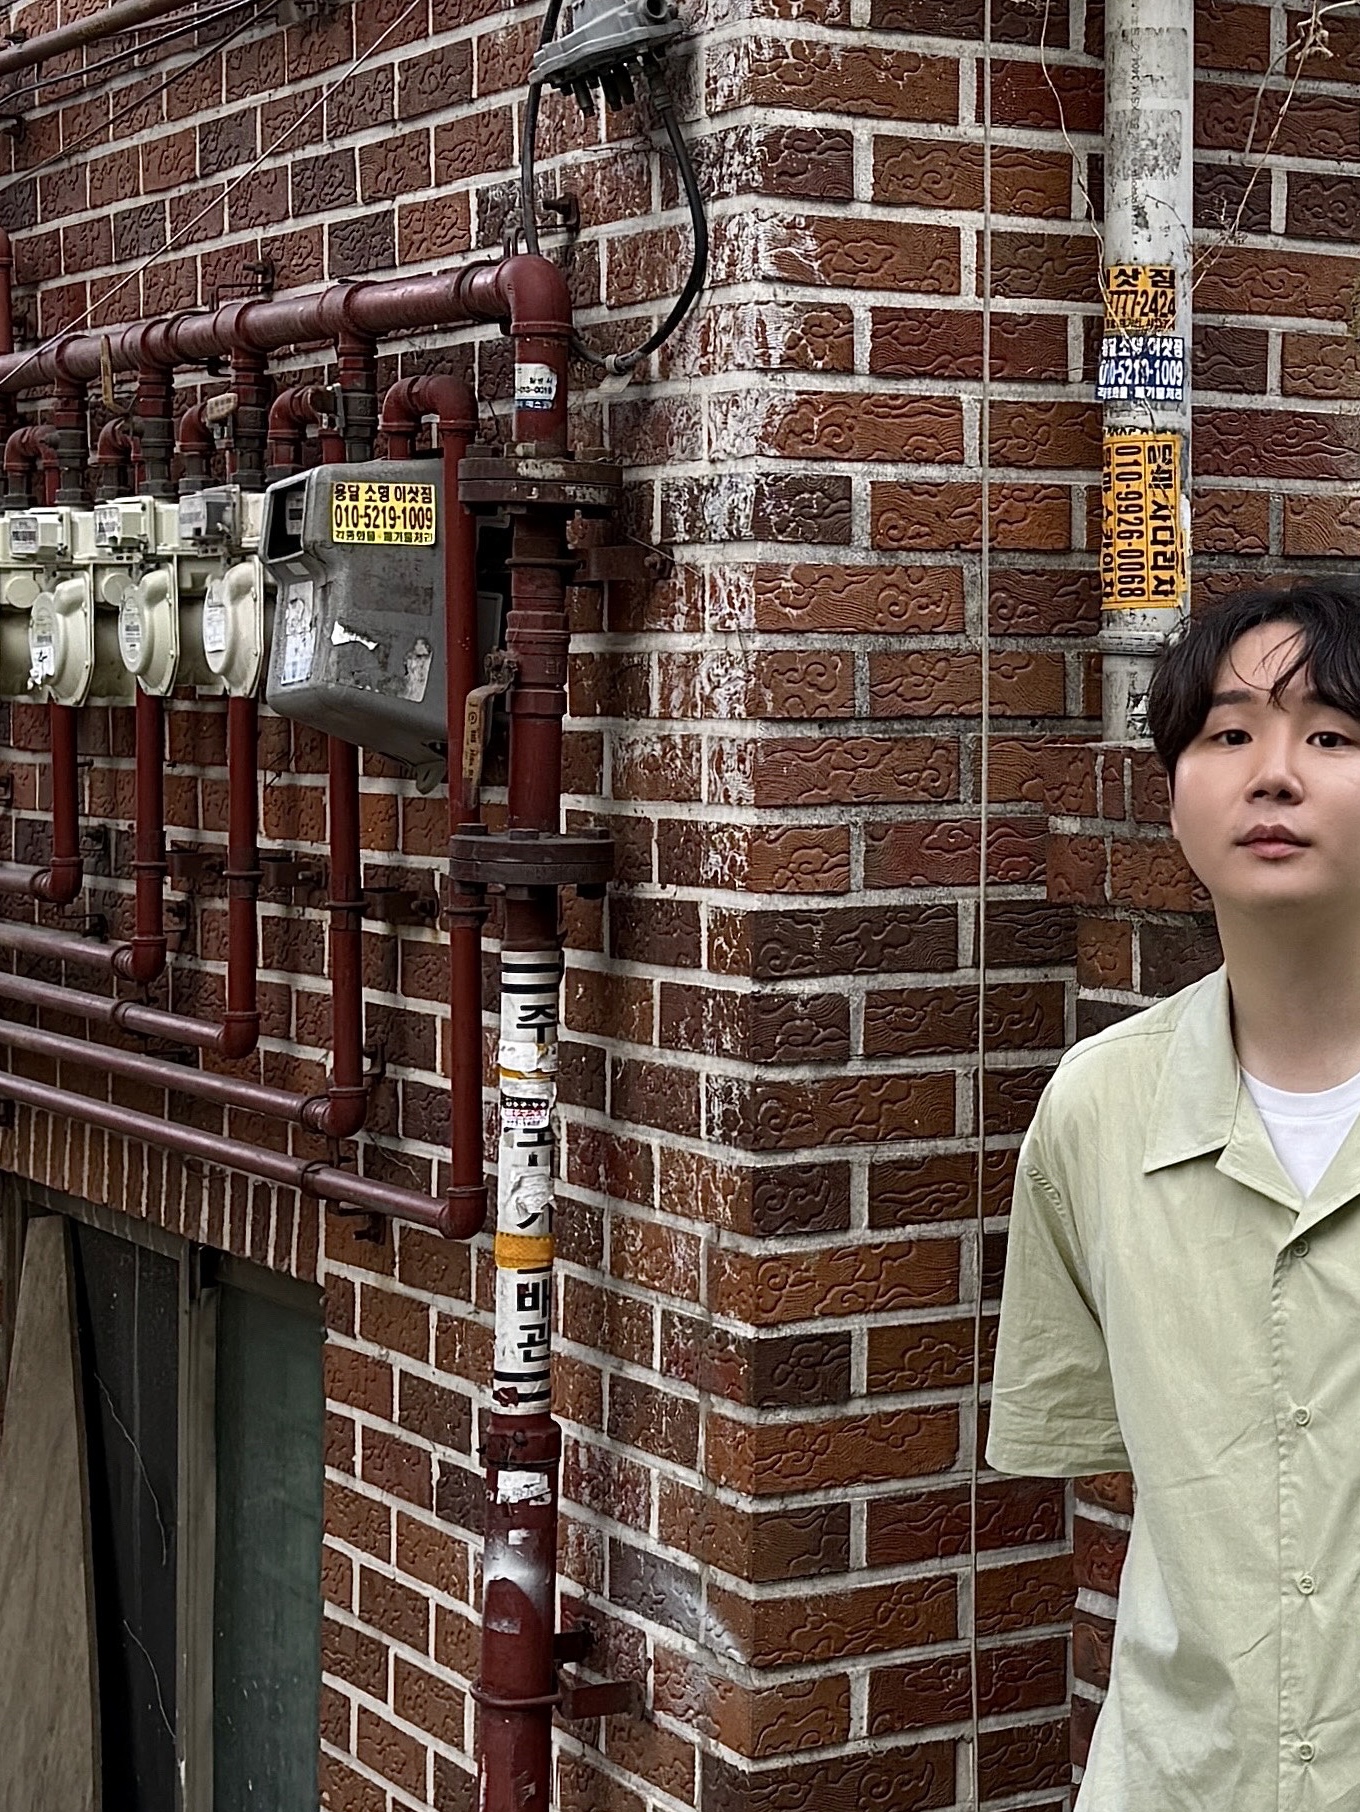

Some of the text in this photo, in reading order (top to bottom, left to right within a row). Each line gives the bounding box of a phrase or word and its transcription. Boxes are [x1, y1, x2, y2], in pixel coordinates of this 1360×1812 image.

[394, 485, 433, 505] 이삿짐
[334, 504, 433, 530] 010-5219-1009
[1149, 500, 1175, 598] 사다리차
